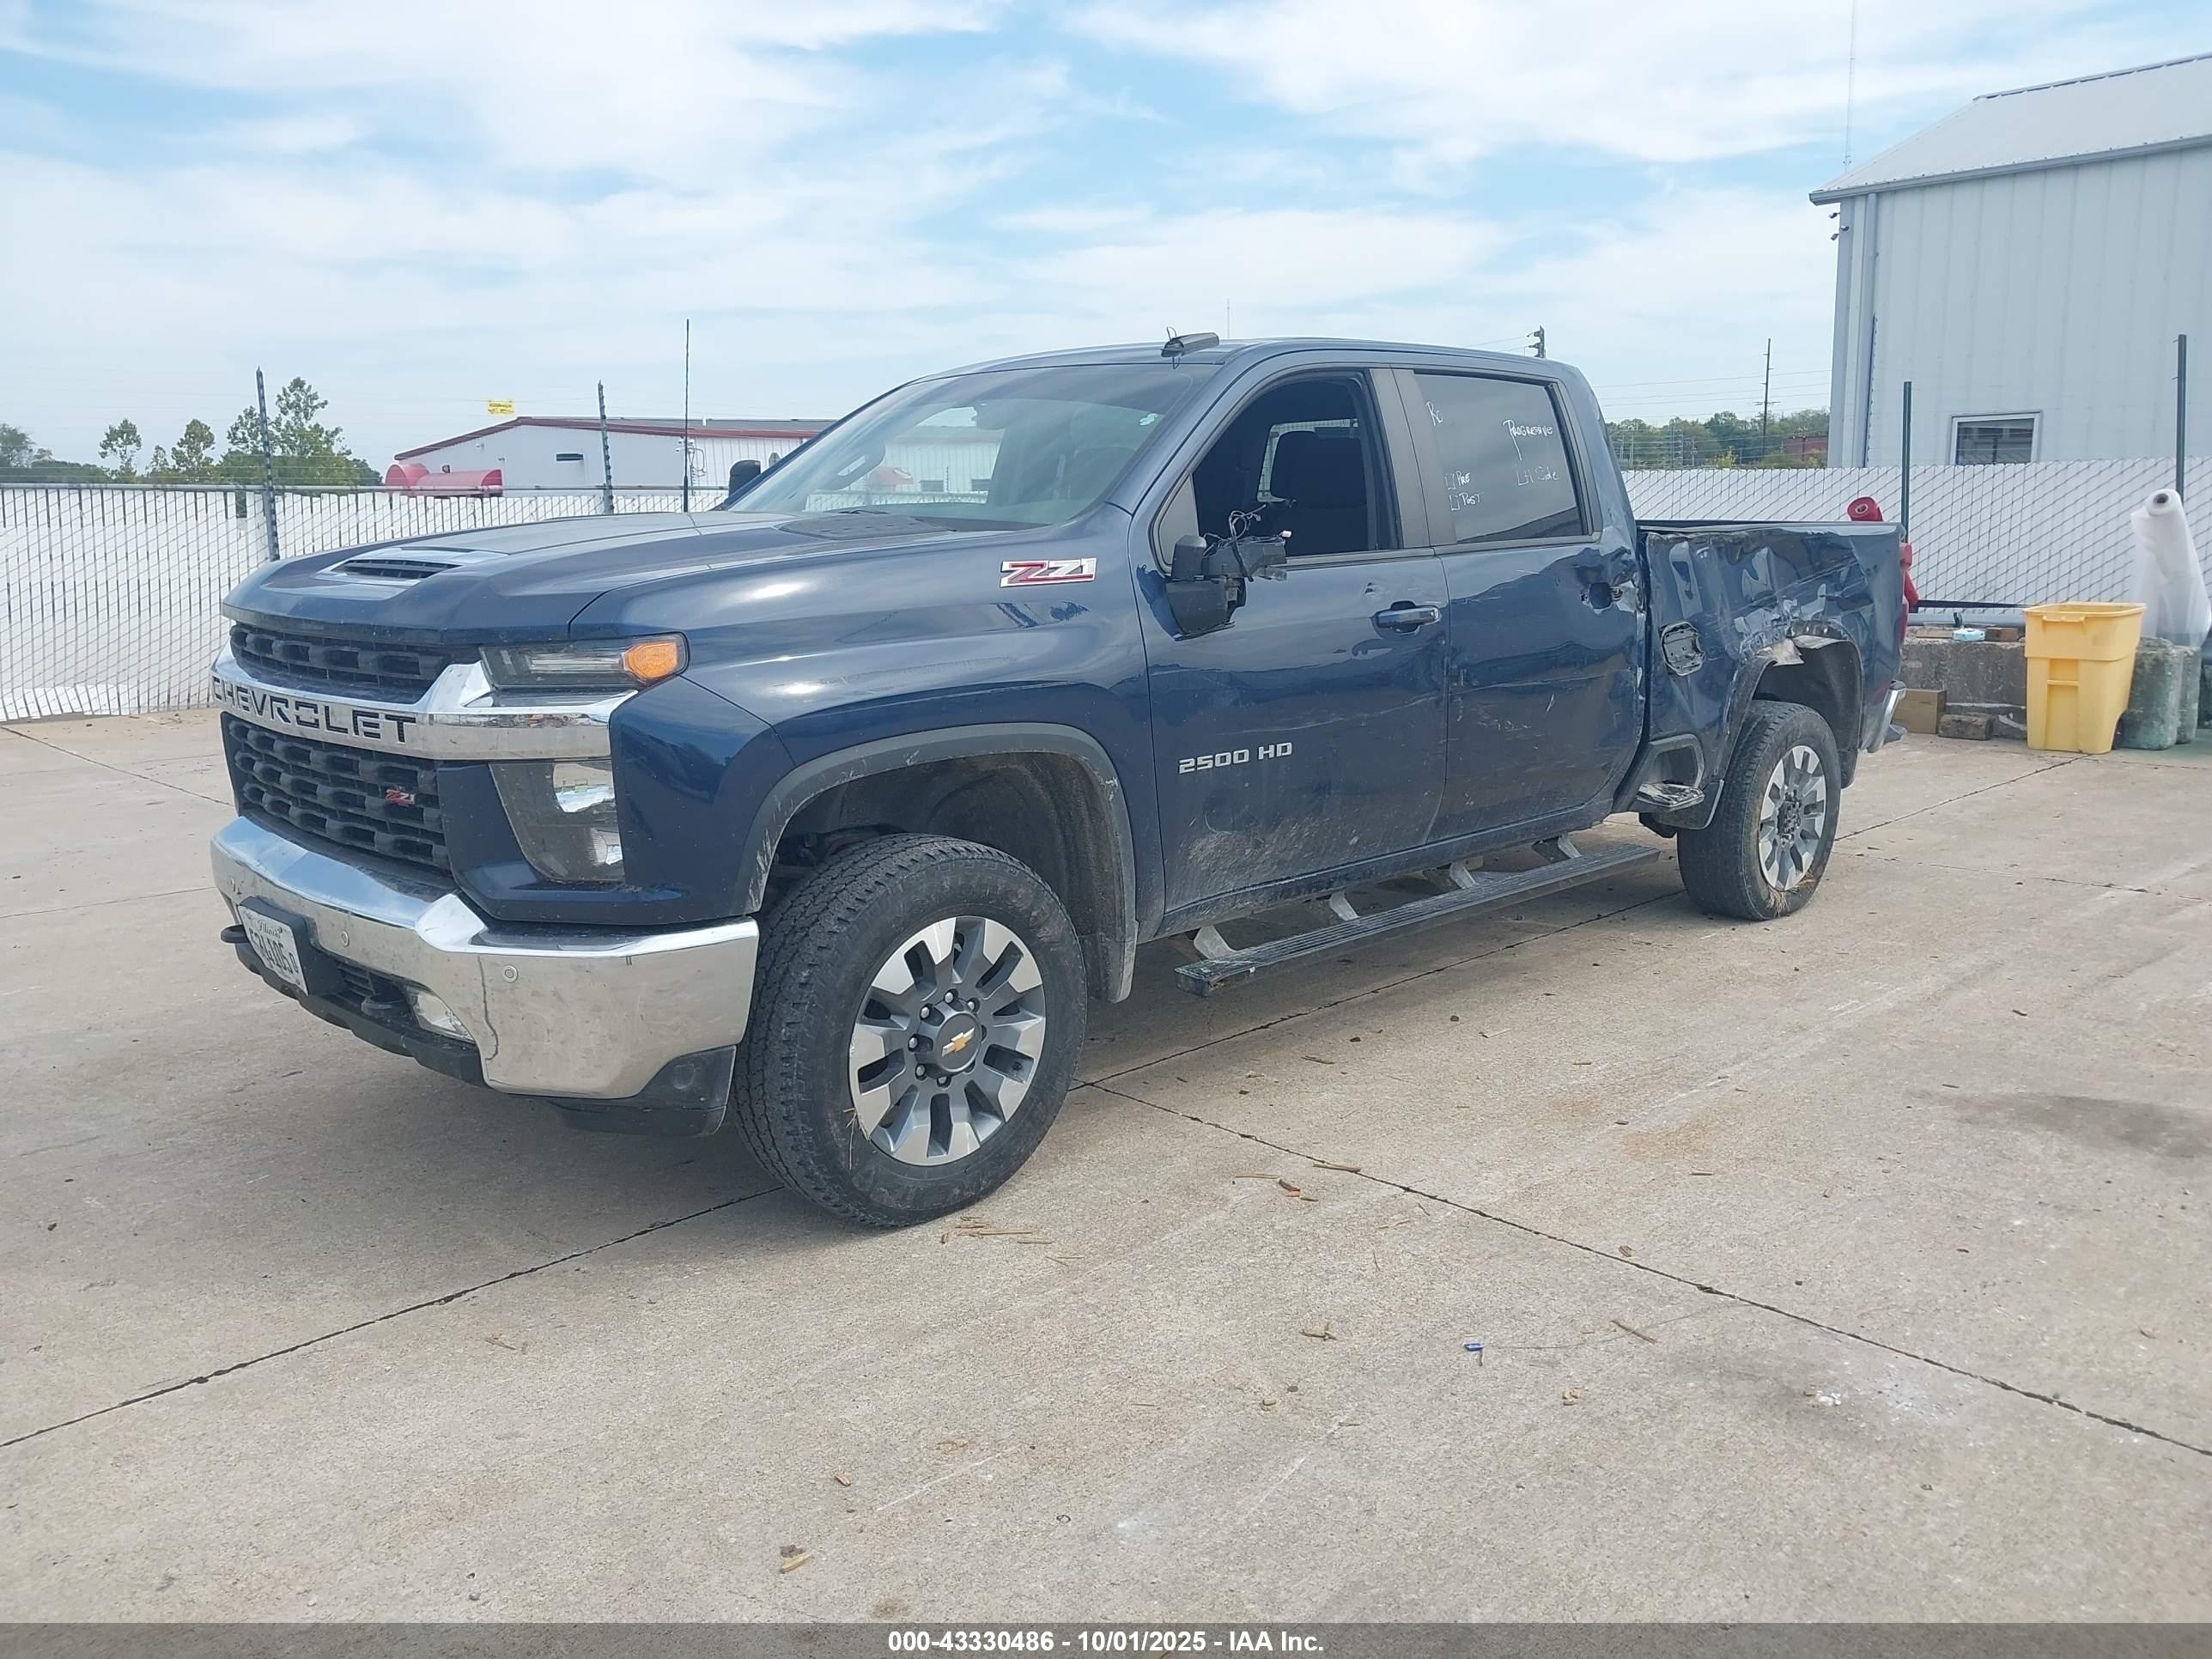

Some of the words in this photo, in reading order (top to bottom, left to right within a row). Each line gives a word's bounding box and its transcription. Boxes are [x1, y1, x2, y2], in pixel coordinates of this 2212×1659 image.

[1000, 557, 1097, 587] Z71
[211, 675, 416, 744] CHEVROLET
[1178, 749, 1249, 775] 2500
[1258, 742, 1292, 760] HD
